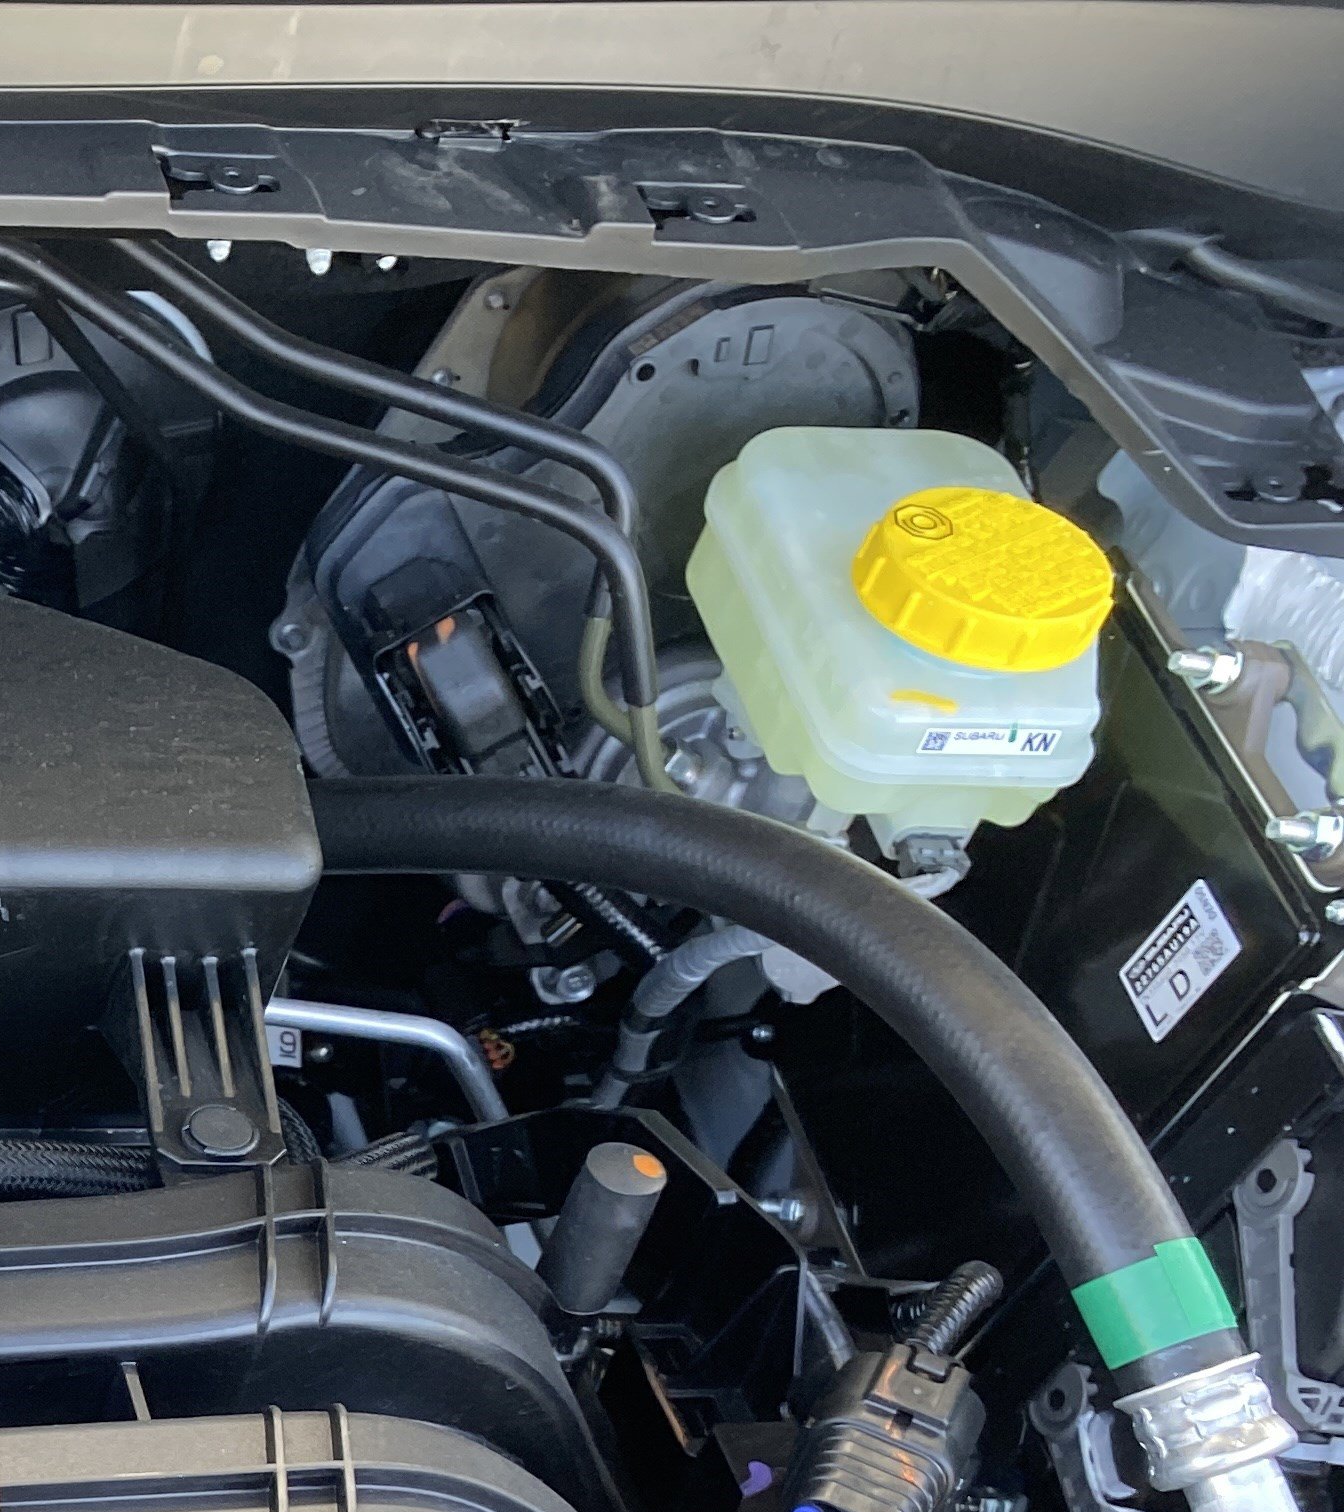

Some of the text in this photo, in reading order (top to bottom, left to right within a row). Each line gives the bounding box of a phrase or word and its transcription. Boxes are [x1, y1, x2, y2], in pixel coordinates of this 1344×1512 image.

[954, 731, 1056, 752] SUBARU KN
[1167, 964, 1193, 1001] D
